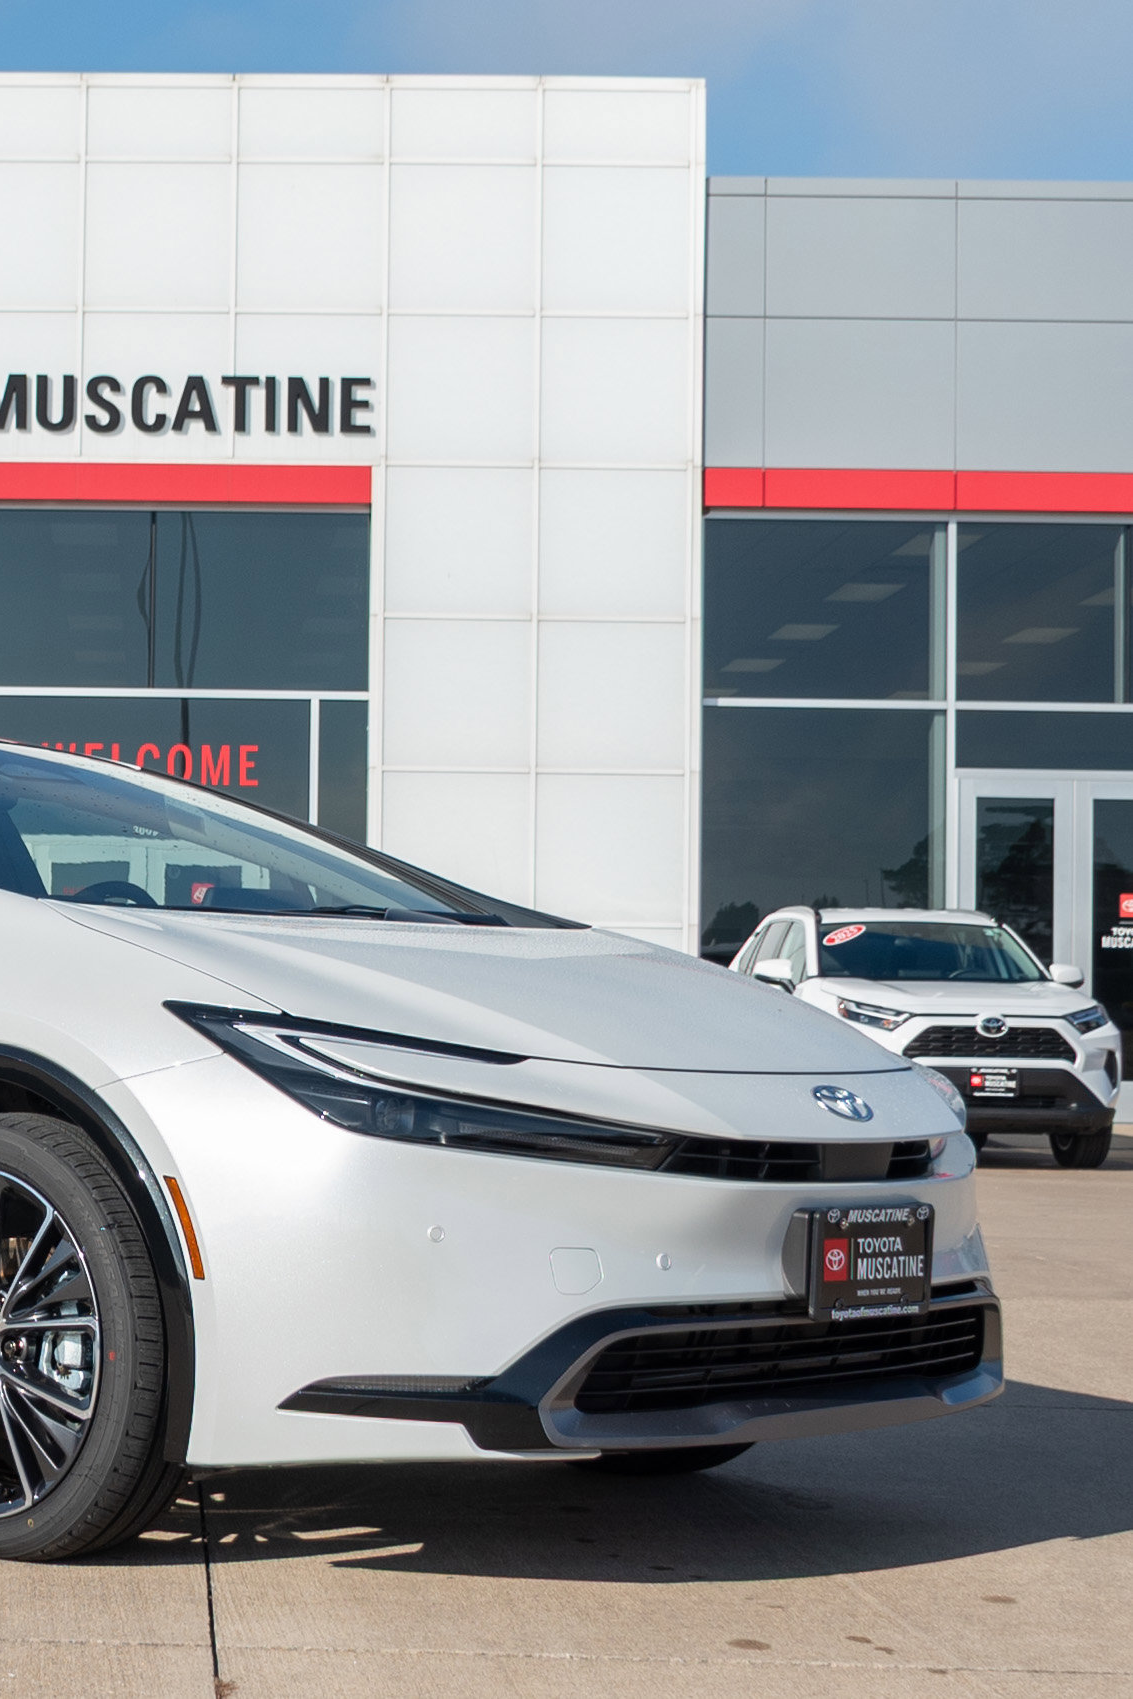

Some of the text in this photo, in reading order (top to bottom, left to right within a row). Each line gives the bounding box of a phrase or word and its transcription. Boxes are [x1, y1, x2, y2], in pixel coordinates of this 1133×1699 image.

[1101, 936, 1133, 949] MUSC
[847, 1208, 909, 1223] MUSCATINE
[857, 1236, 903, 1254] TOYOTA
[857, 1255, 924, 1280] MUSCATINE
[831, 1305, 918, 1320] toyotaofmuscatine.com
